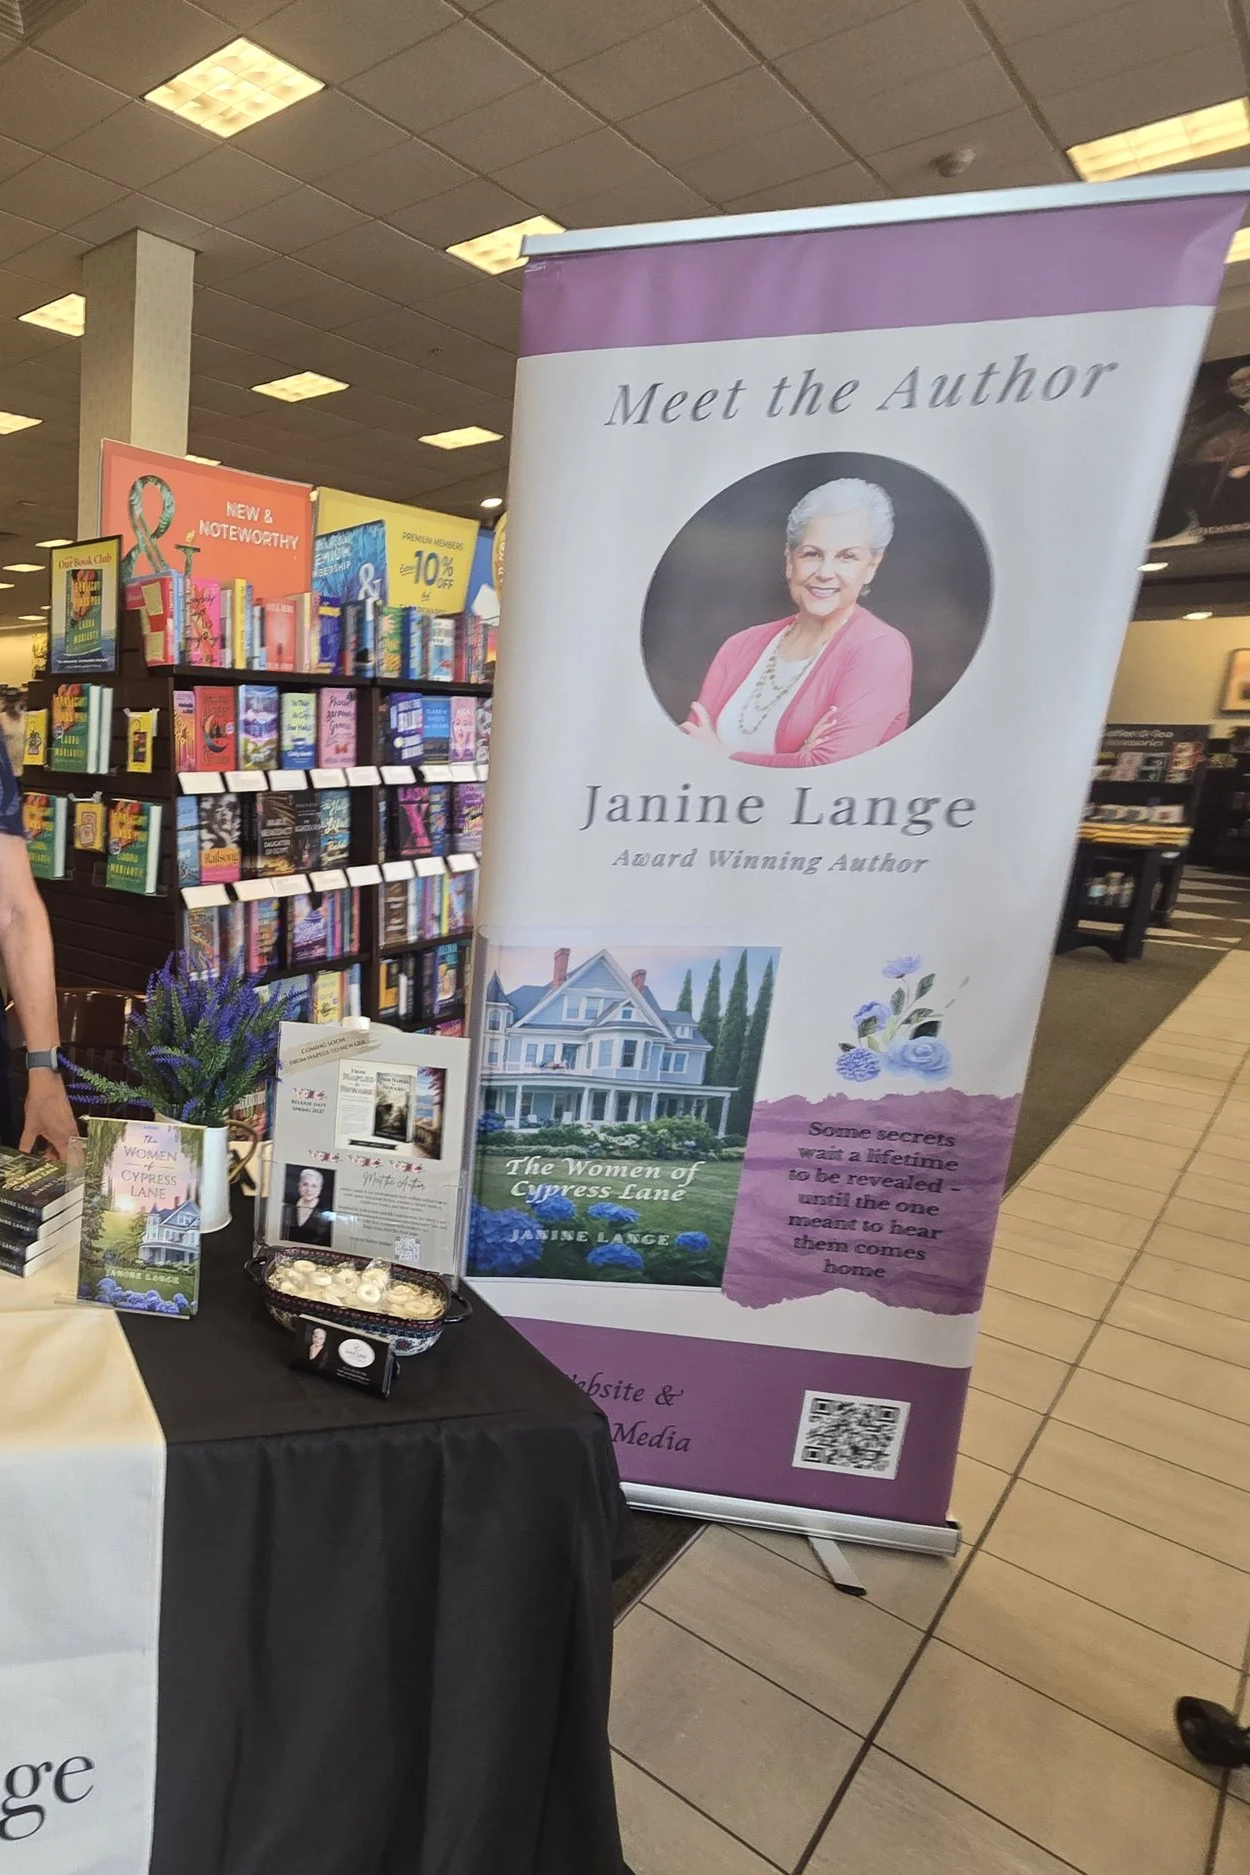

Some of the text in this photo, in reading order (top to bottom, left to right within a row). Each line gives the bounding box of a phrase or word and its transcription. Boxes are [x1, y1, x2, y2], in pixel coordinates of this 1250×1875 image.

[604, 352, 1120, 427] Meet the Author
[226, 501, 274, 524] NEW &
[199, 519, 300, 550] NOTEWORTHY
[402, 531, 464, 551] PREMIUM MEMBERS
[58, 553, 111, 569] Our Book Club
[437, 579, 454, 590] OFF
[579, 783, 978, 837] Janine Lange
[612, 848, 931, 875] Award Winning Author
[301, 1037, 346, 1055] COMING SOON
[143, 1134, 158, 1145] The
[808, 1121, 957, 1147] Some secrets
[123, 1145, 178, 1161] WOMEN
[798, 1145, 959, 1172] wait a lifetime
[121, 1169, 178, 1186] CYPRESS
[505, 1155, 706, 1188] The Women of
[788, 1168, 810, 1182] to
[814, 1168, 841, 1184] be
[846, 1173, 944, 1193] revealed
[130, 1185, 166, 1200] LANE
[510, 1180, 687, 1204] Cypress Lane
[17, 1202, 35, 1214] LANGE
[798, 1192, 940, 1216] until the one
[12, 1221, 31, 1233] LANGE
[509, 1229, 671, 1246] JANINE LANGE
[788, 1215, 943, 1240] meant to hear
[2, 1240, 19, 1251] LANGE
[793, 1234, 926, 1261] them comes
[0, 1259, 18, 1271] LANGE
[822, 1258, 886, 1278] home
[566, 1372, 684, 1407] ebsite &
[611, 1420, 692, 1452] Media
